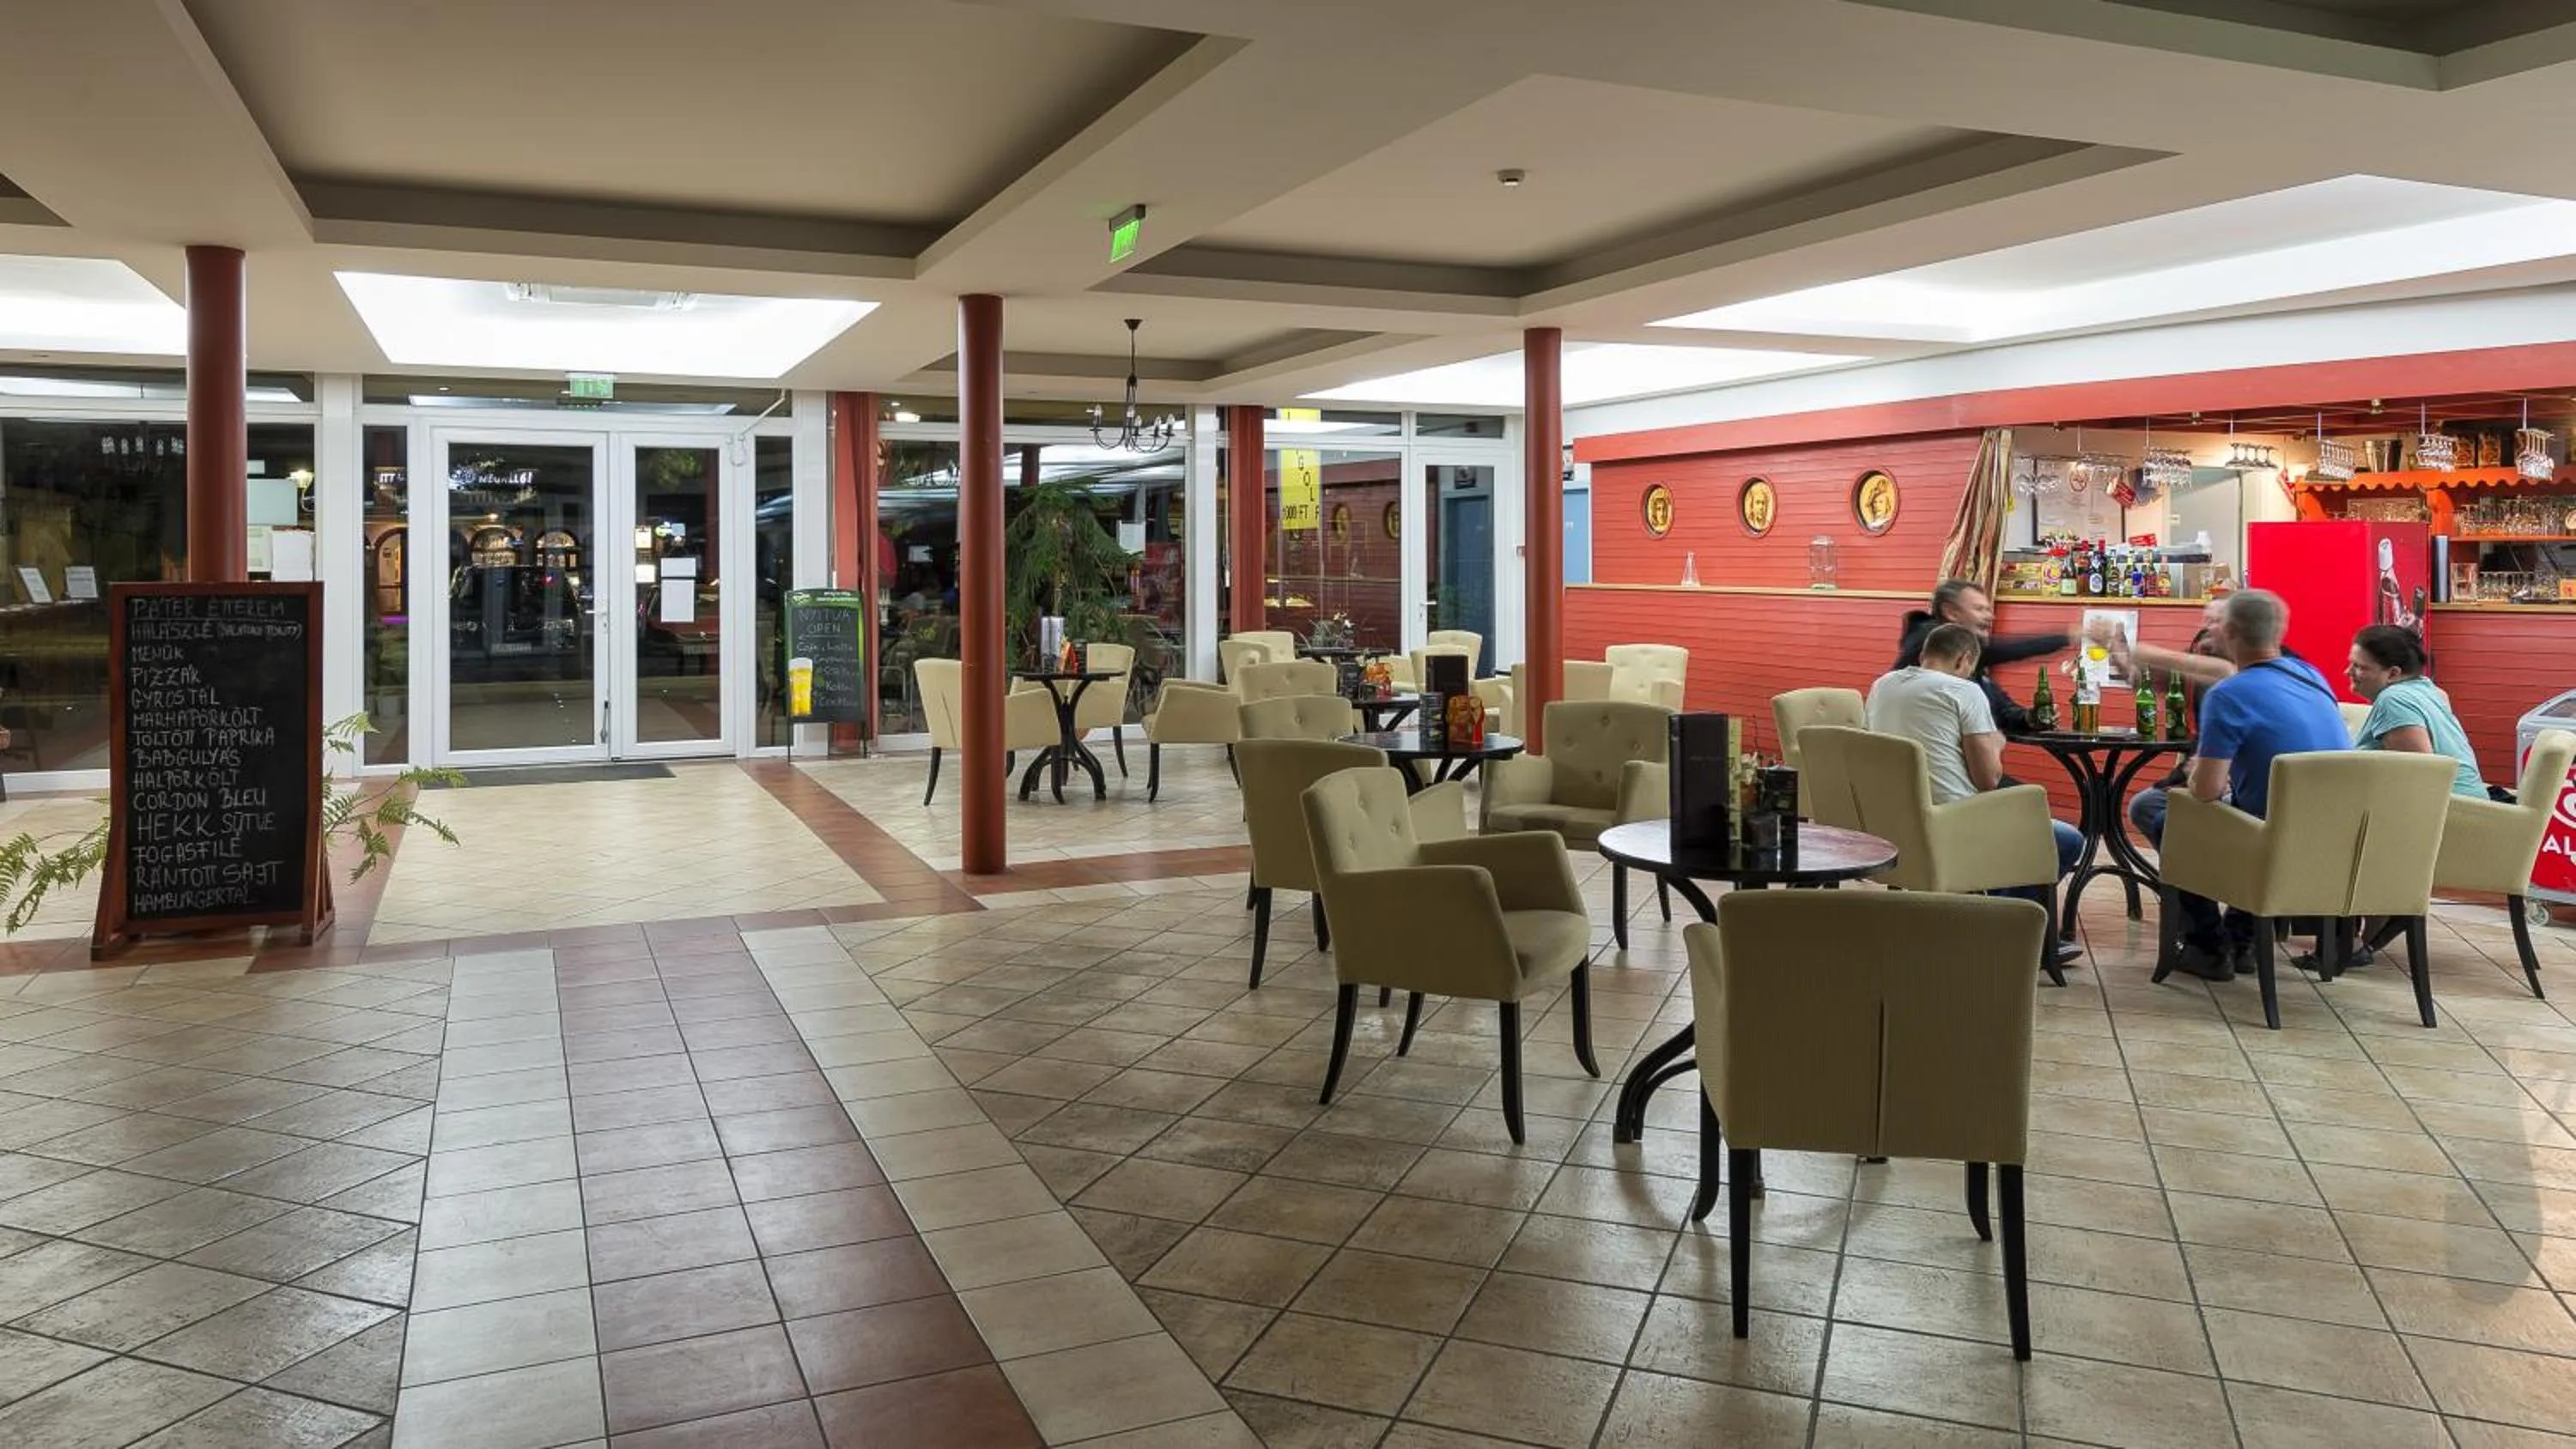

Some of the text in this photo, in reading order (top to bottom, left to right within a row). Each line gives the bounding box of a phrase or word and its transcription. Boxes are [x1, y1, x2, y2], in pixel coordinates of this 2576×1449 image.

[203, 727, 276, 748] PAPRIKA
[133, 745, 241, 768] BABGULYÁS
[133, 787, 266, 811] CORDON BLEU
[137, 812, 216, 842] HEKK
[222, 860, 285, 885] SAJT
